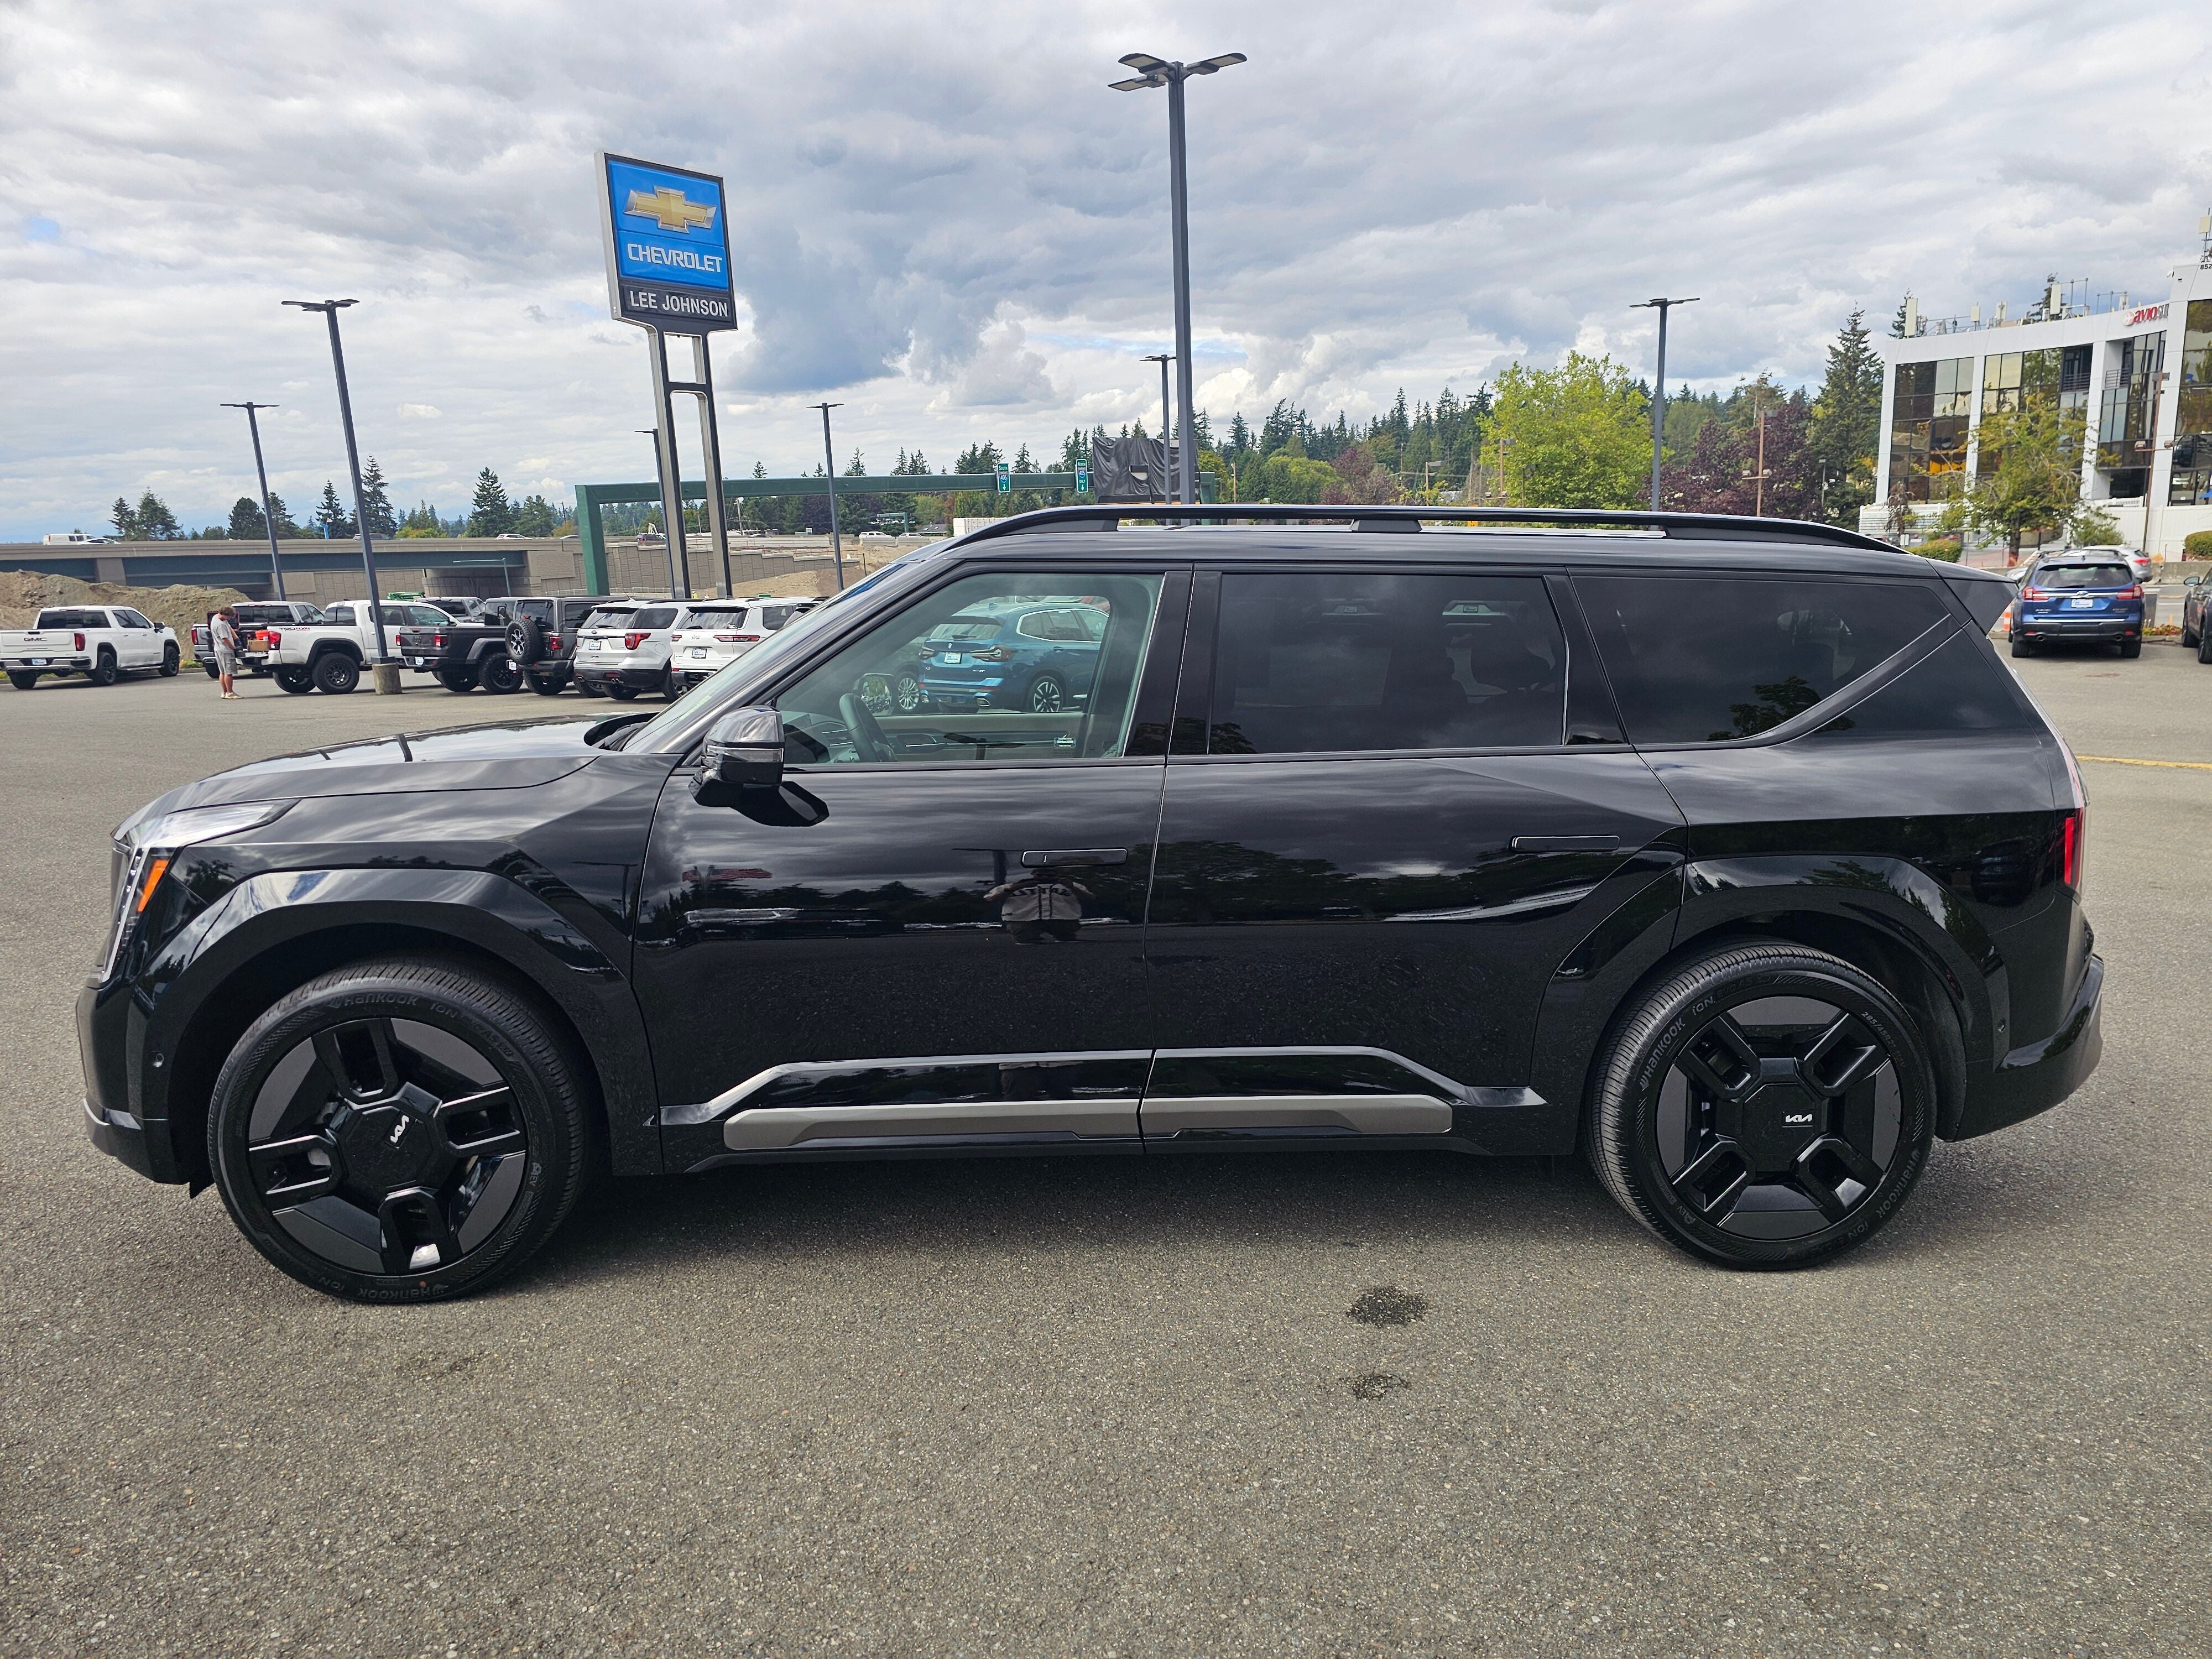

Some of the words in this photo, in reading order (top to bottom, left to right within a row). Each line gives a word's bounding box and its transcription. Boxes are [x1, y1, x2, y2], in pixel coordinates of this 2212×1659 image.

[628, 243, 722, 273] CHEVROLET
[630, 290, 658, 309] LEE
[662, 295, 728, 317] JOHNSON
[344, 992, 419, 1006] Hankook
[1644, 1017, 1686, 1077] Hankook
